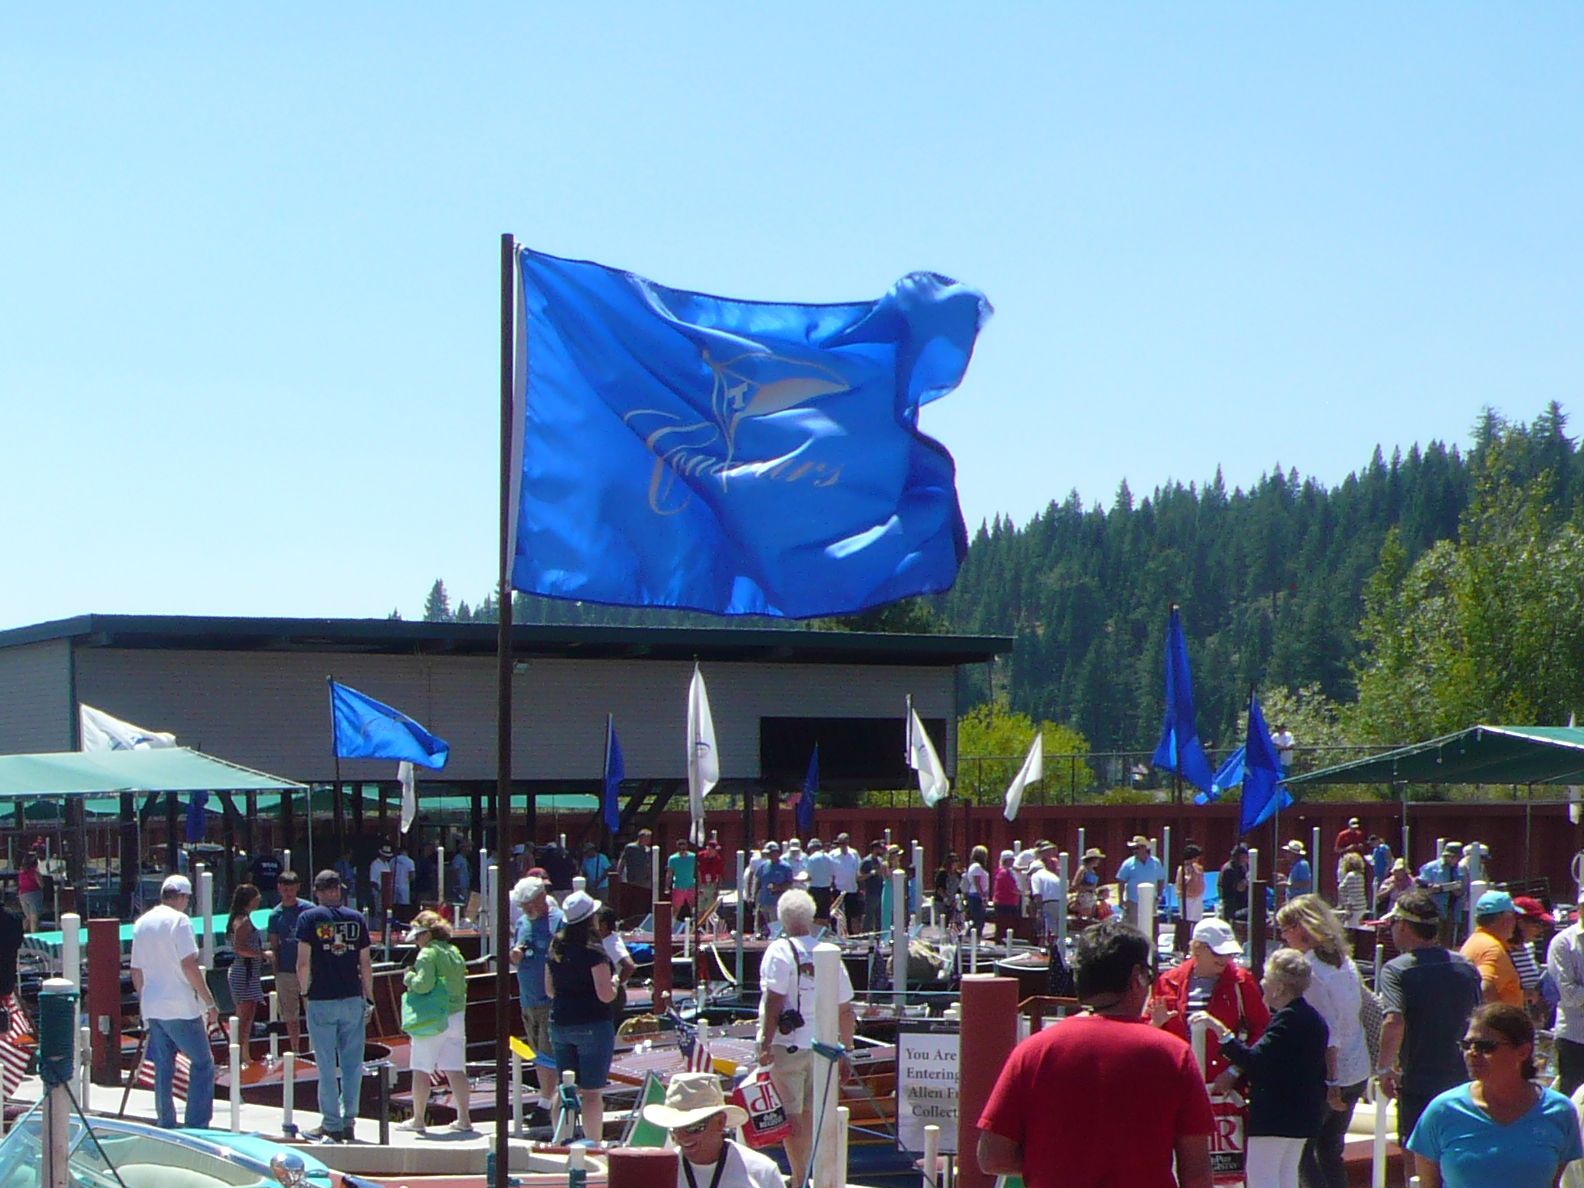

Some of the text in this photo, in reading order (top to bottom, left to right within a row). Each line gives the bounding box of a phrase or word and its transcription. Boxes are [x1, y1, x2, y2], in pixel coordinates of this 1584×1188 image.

[905, 1047, 958, 1062] You Are
[908, 1085, 943, 1099] Allen
